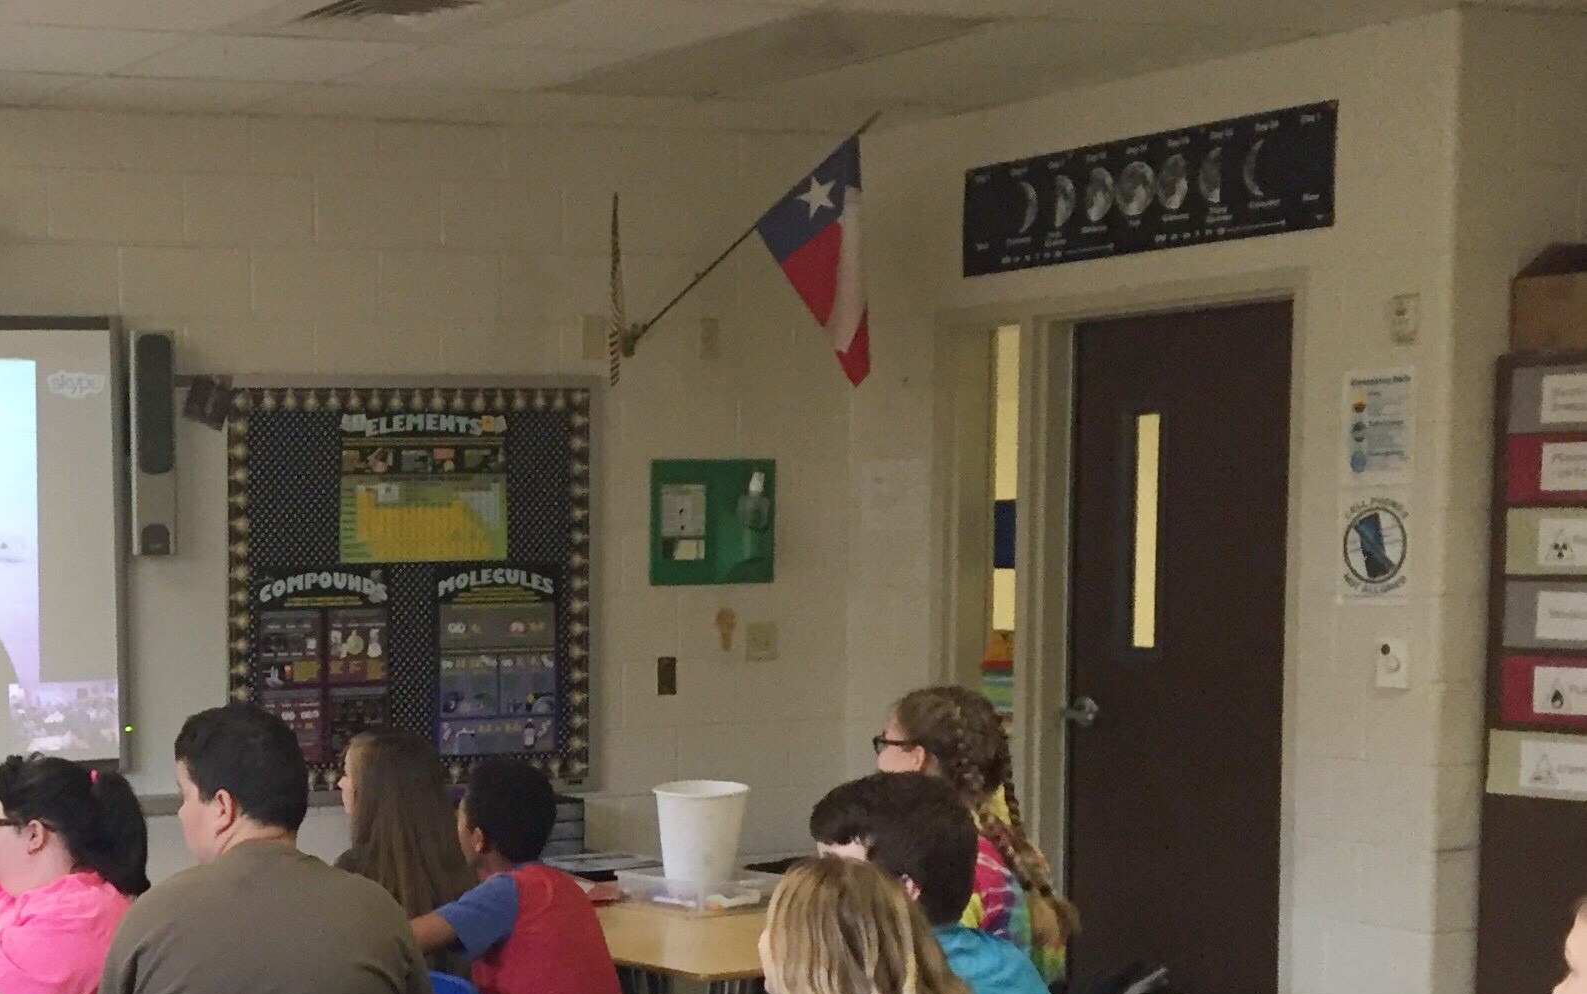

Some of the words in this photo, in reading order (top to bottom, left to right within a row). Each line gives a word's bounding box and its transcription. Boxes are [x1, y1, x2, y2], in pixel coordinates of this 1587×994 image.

[365, 413, 482, 437] ELEMENTS
[259, 571, 388, 604] COMPOUNDS
[438, 567, 555, 596] MOLECULES
